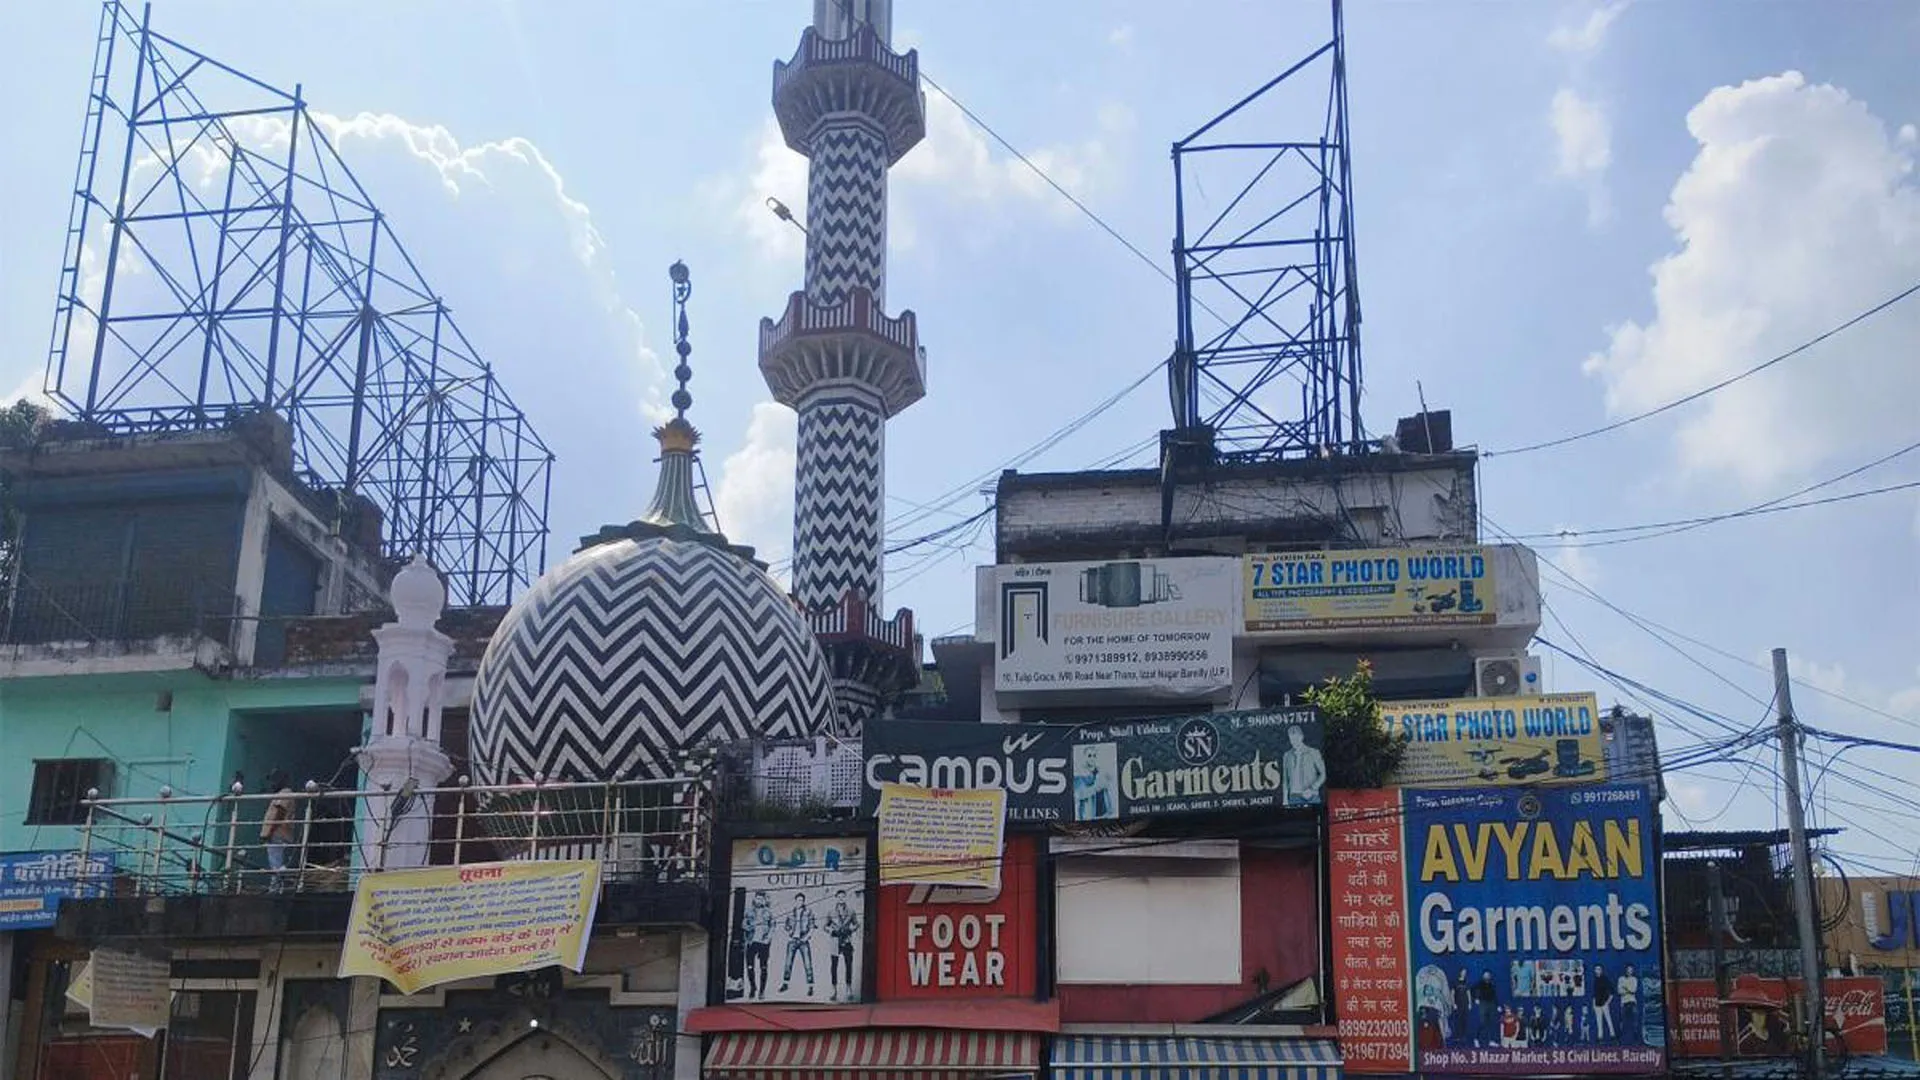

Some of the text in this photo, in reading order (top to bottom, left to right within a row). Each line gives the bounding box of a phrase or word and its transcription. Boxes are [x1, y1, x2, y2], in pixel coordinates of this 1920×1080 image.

[1252, 554, 1485, 586] 7 STAR PHOTO WORLD
[1151, 606, 1228, 626] GALLERY
[1064, 632, 1211, 646] FOR THE HOME OF TOMORROW
[1075, 670, 1094, 680] Road
[1402, 712, 1449, 743] STAR
[1455, 709, 1517, 741] PHOTO
[1523, 705, 1592, 738] WORLD
[1080, 728, 1105, 741] Prop.
[1184, 738, 1213, 759] SN
[1121, 749, 1281, 800] Garments
[1024, 808, 1059, 820] LINES
[1343, 828, 1389, 847] मोहरें
[1420, 818, 1643, 882] AVYAAN
[459, 866, 504, 883] सूचना
[767, 873, 827, 886] OUTFIT
[1372, 870, 1388, 886] की
[1343, 891, 1395, 908] नेम प्लेट
[1384, 910, 1400, 928] की
[1420, 891, 1653, 953] Garments
[908, 914, 1006, 950] FOOT
[1346, 932, 1393, 950] नम्बर प्लेट
[907, 951, 1005, 986] WEAR
[1346, 995, 1400, 1013] की नेम प्लेट
[1679, 1012, 1721, 1025] PROUDL
[1424, 1051, 1449, 1067] Shop
[1452, 1051, 1469, 1064] No.
[1471, 1050, 1478, 1064] 3
[1480, 1050, 1510, 1064] Mazar
[1512, 1050, 1551, 1066] Market,
[1568, 1049, 1590, 1063] Civil
[1623, 1048, 1662, 1066] Bareilly
